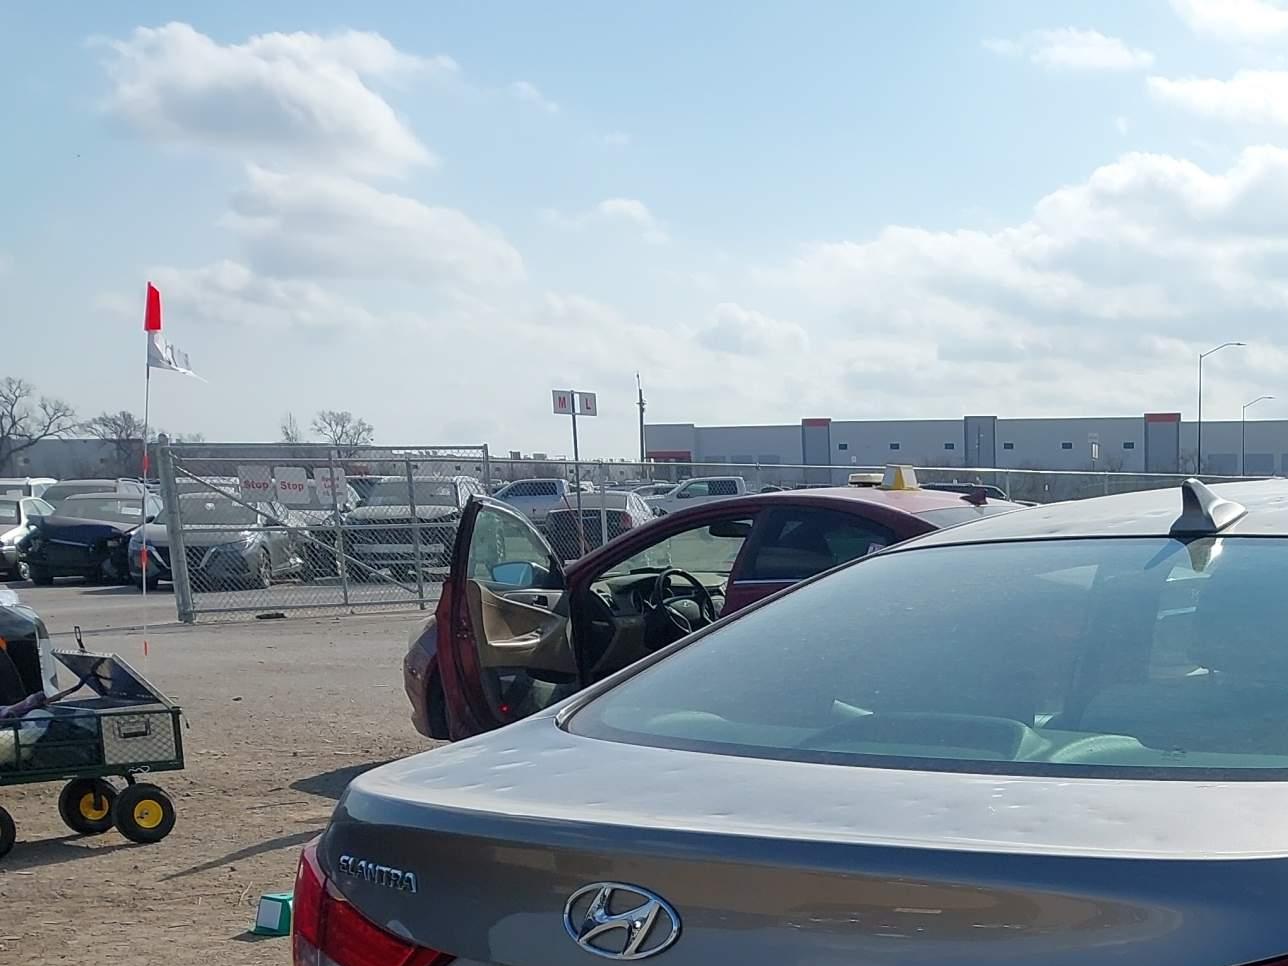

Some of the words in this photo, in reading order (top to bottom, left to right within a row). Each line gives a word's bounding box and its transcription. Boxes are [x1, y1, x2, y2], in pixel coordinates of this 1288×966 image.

[558, 396, 567, 409] M
[584, 397, 592, 410] L
[243, 480, 269, 491] Stop
[280, 481, 304, 492] Stop
[339, 855, 417, 893] ELANTRA
